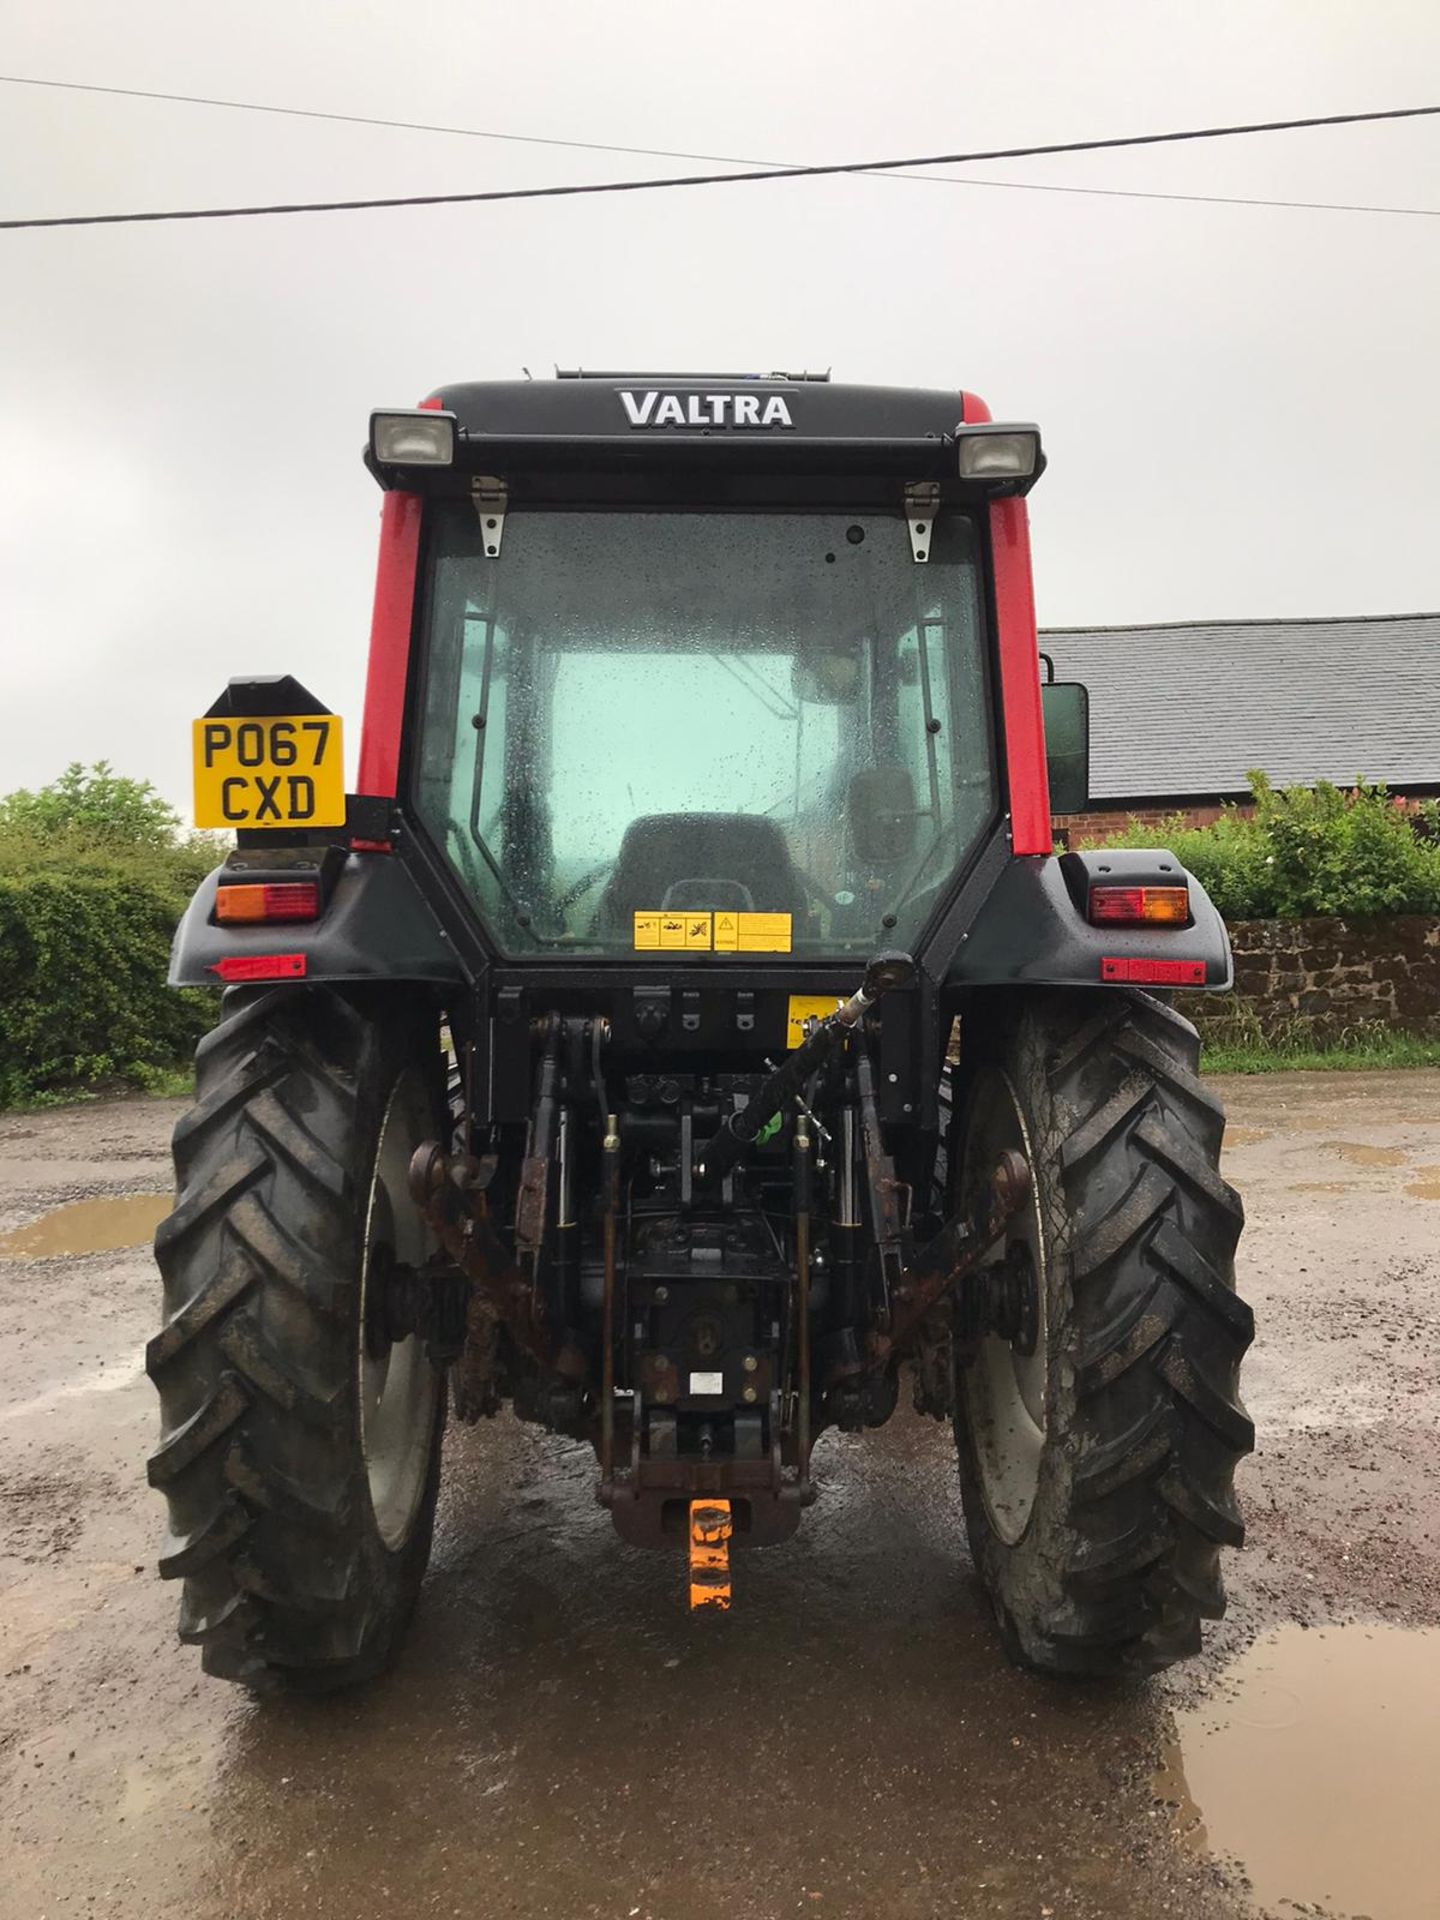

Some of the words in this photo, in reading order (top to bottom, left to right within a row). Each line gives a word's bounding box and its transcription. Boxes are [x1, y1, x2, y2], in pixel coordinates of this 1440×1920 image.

[620, 391, 793, 426] VALTRA
[204, 722, 330, 768] PO67
[222, 775, 315, 821] CXD
